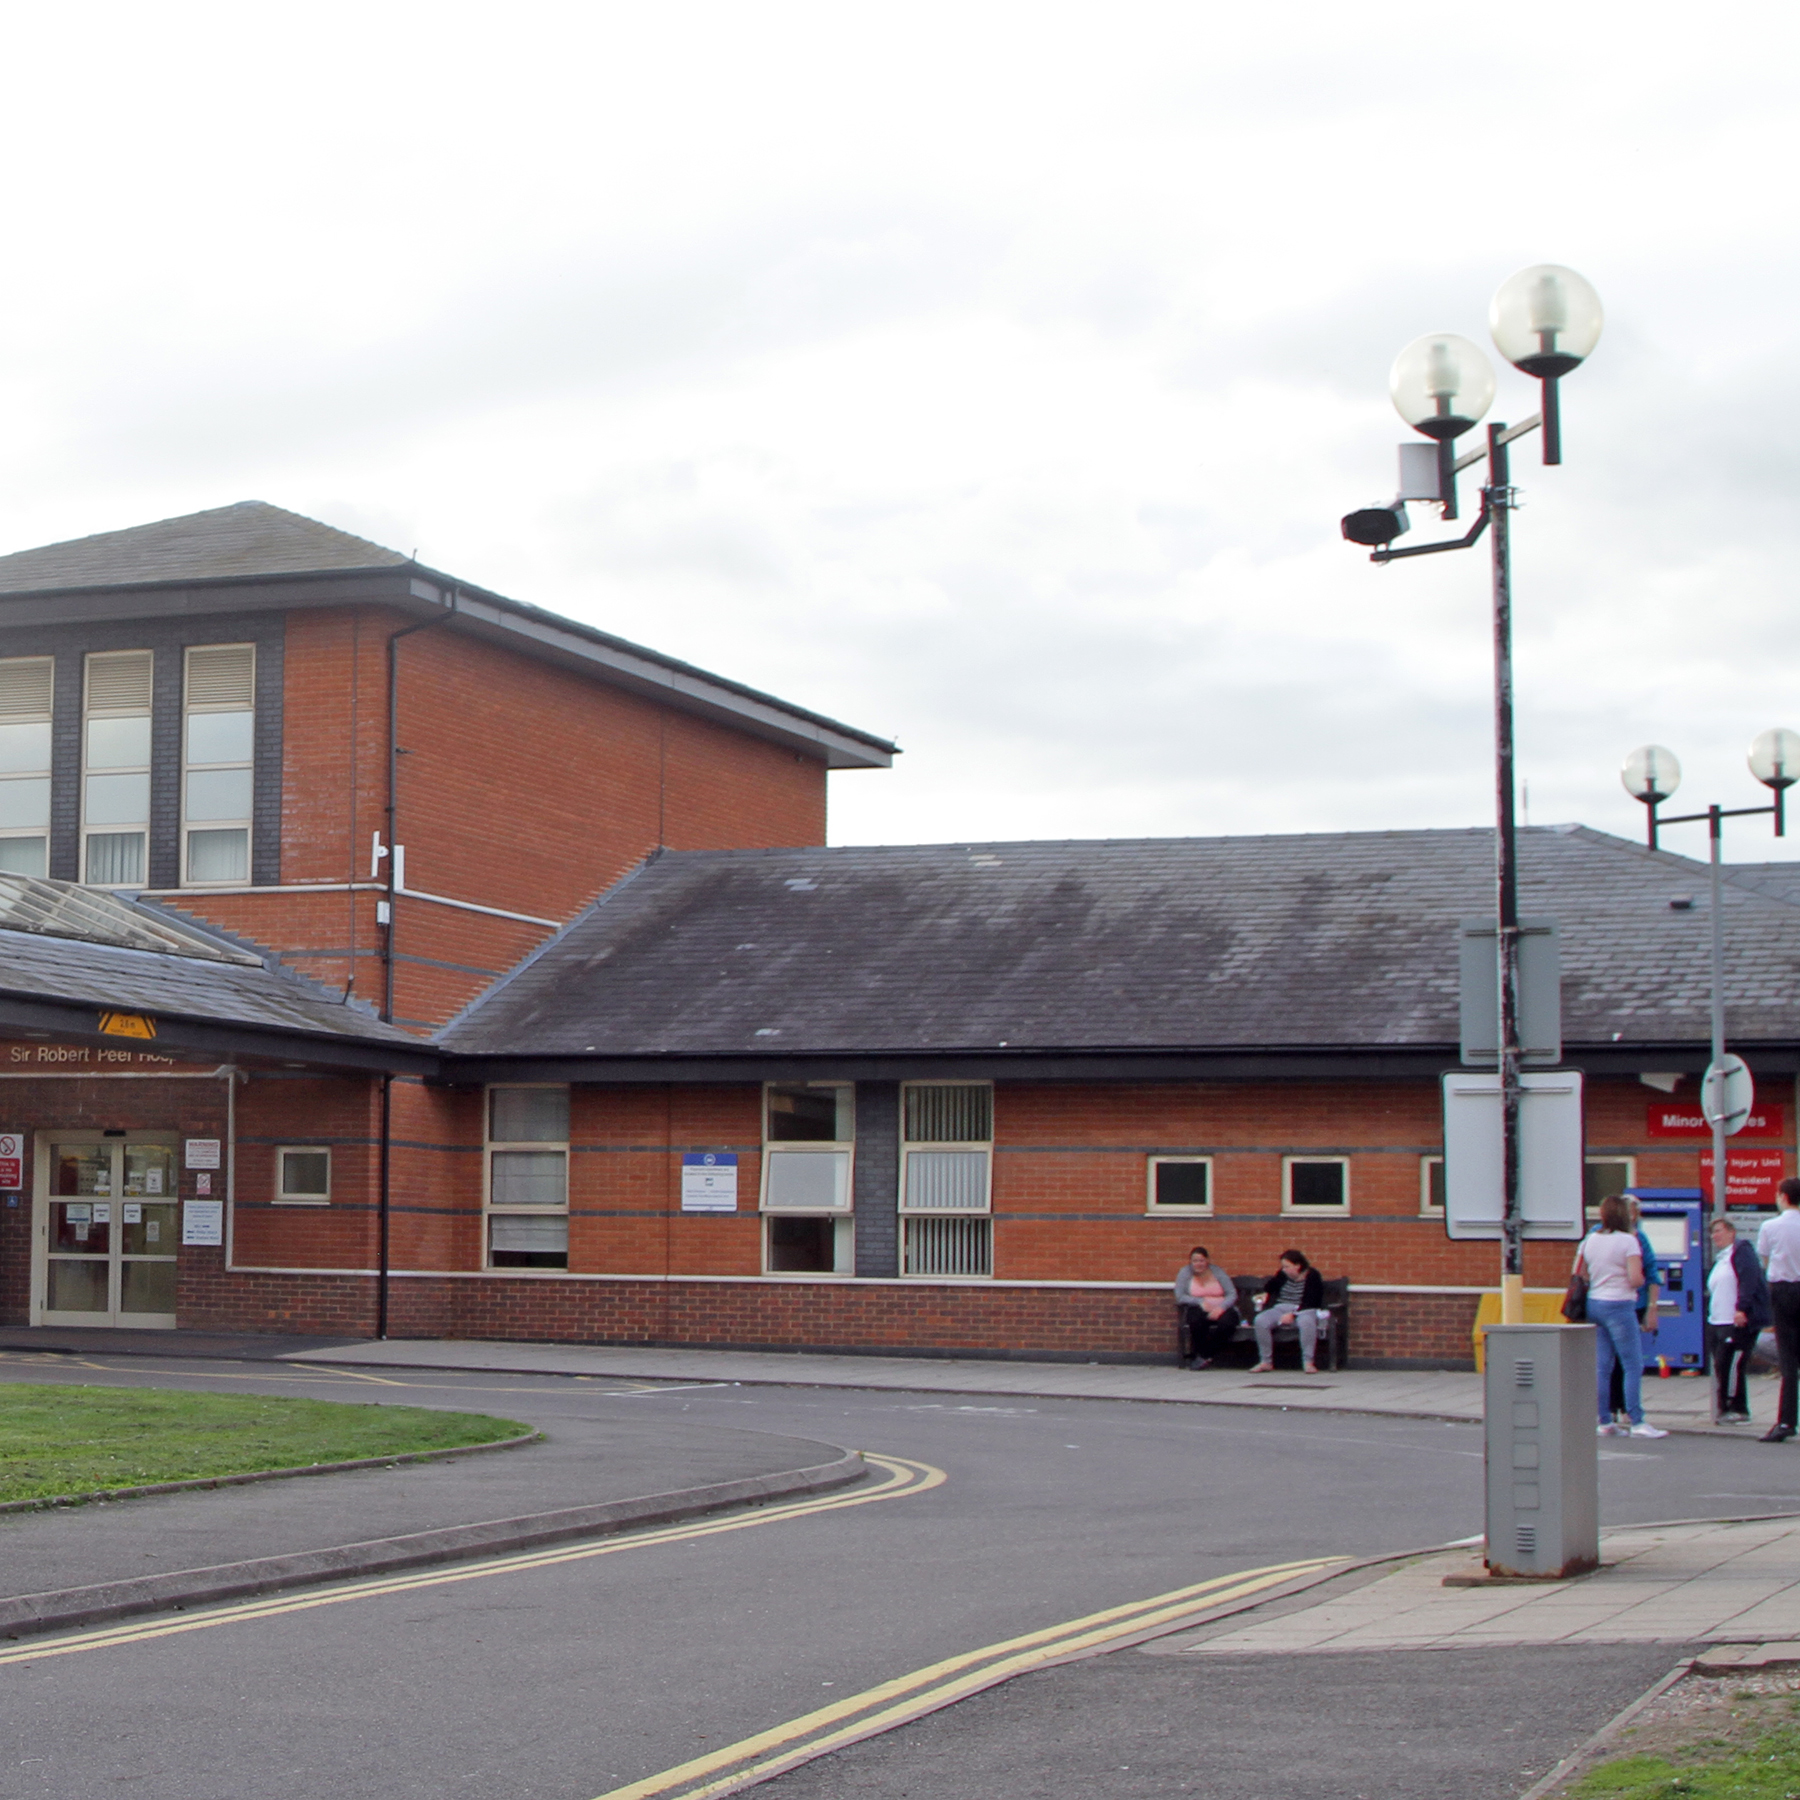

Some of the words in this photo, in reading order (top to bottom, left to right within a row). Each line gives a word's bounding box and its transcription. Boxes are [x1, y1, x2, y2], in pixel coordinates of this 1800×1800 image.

[10, 1047, 30, 1062] Sir
[37, 1047, 90, 1062] Robert
[97, 1048, 132, 1062] Peel
[1662, 1114, 1705, 1128] Minor
[1731, 1158, 1758, 1168] Injury
[1762, 1158, 1781, 1166] Unit
[1728, 1176, 1771, 1184] Resident
[1725, 1186, 1758, 1194] Doctor
